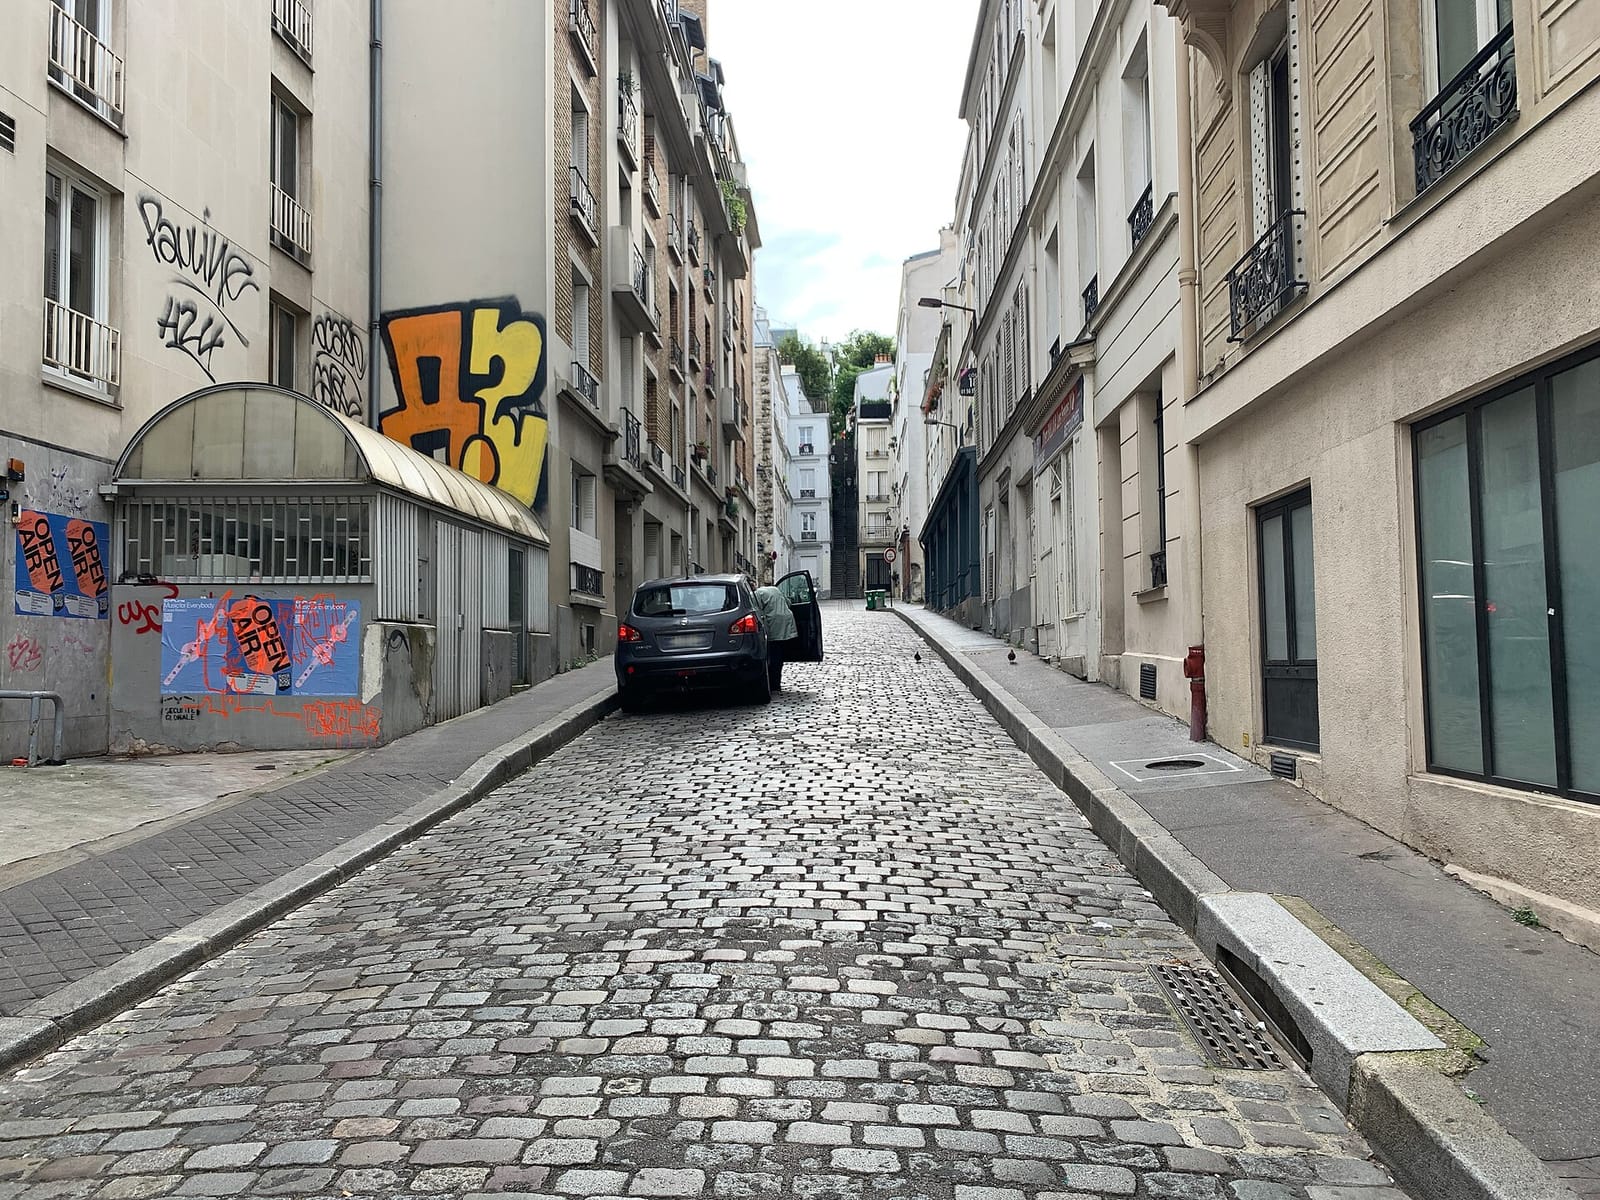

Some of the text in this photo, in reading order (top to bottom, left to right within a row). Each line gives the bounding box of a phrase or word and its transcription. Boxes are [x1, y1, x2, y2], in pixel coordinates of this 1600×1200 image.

[18, 529, 42, 572] AIR
[34, 518, 64, 592] OPEN
[67, 537, 88, 577] AIR
[82, 526, 107, 597] OPEN
[231, 618, 261, 656] AIR
[252, 605, 291, 673] OPEN
